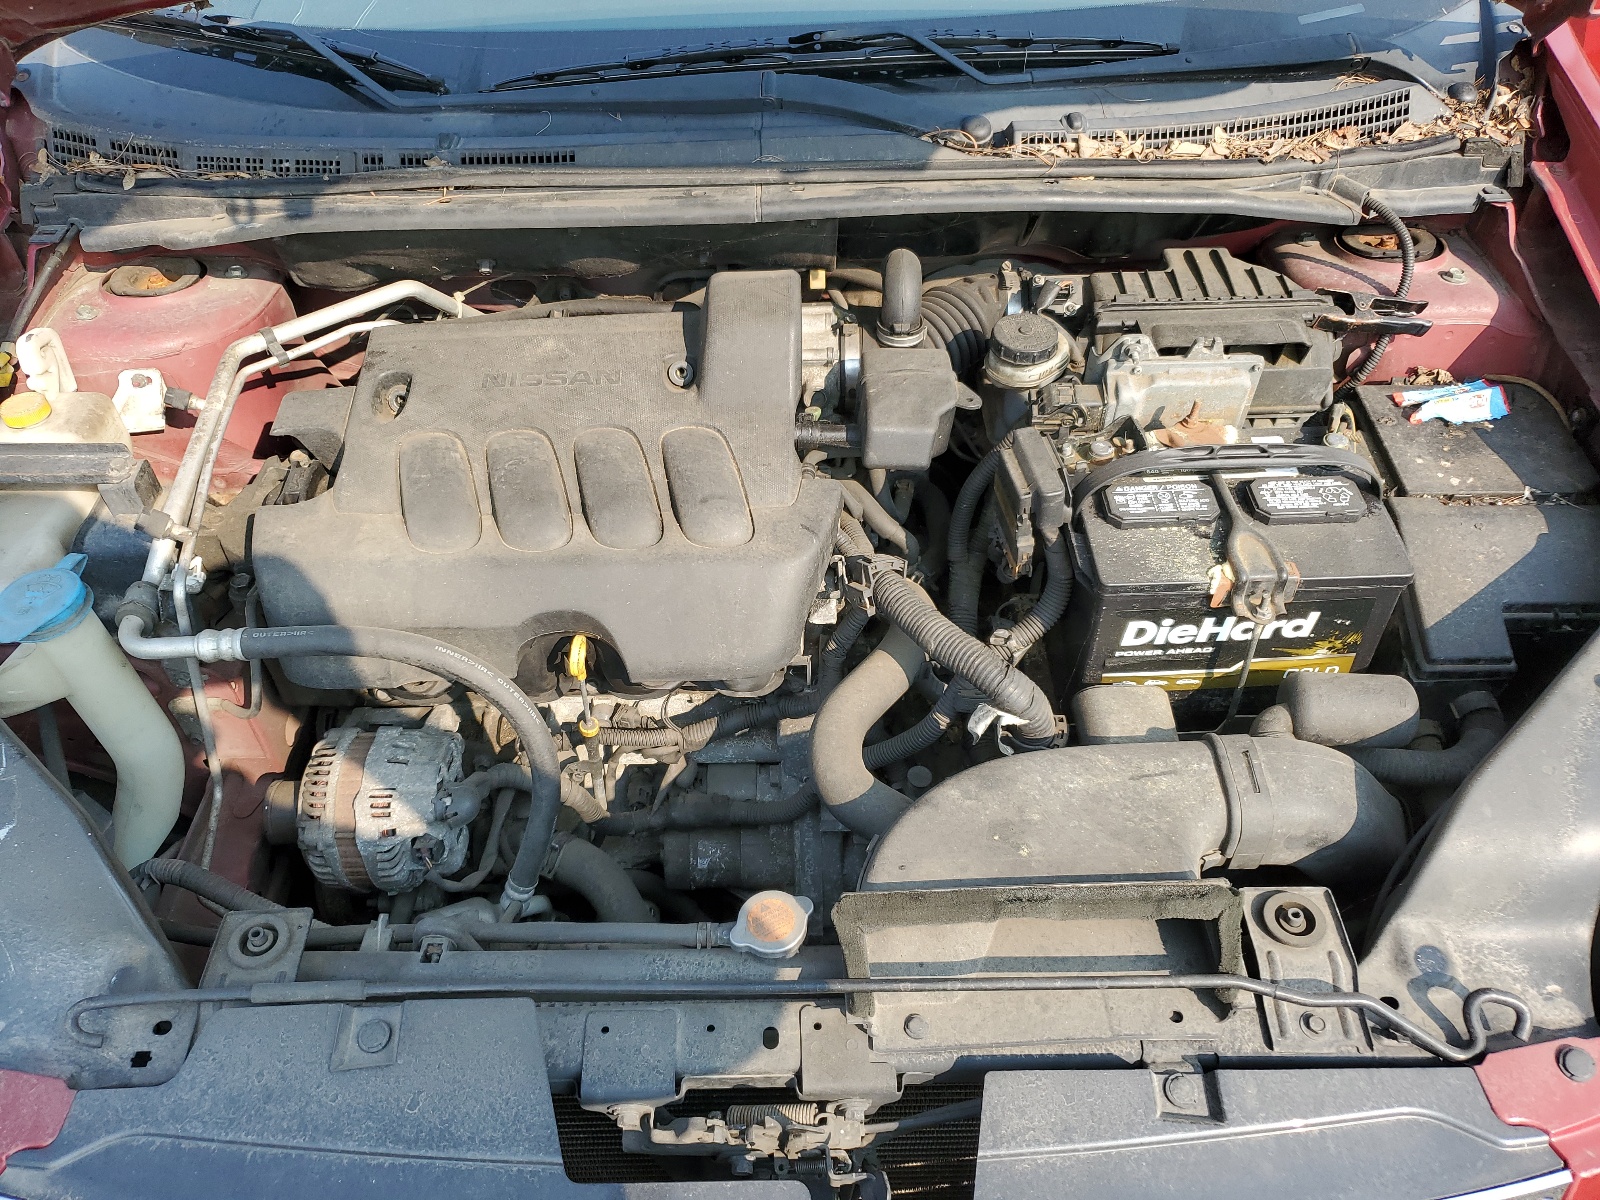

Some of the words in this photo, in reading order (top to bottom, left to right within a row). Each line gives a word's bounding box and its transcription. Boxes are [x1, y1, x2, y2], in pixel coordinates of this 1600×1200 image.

[481, 370, 622, 389] NISSAN
[1120, 611, 1321, 647] DieHard
[1115, 648, 1163, 657] POWER
[1163, 646, 1212, 655] AHEAD
